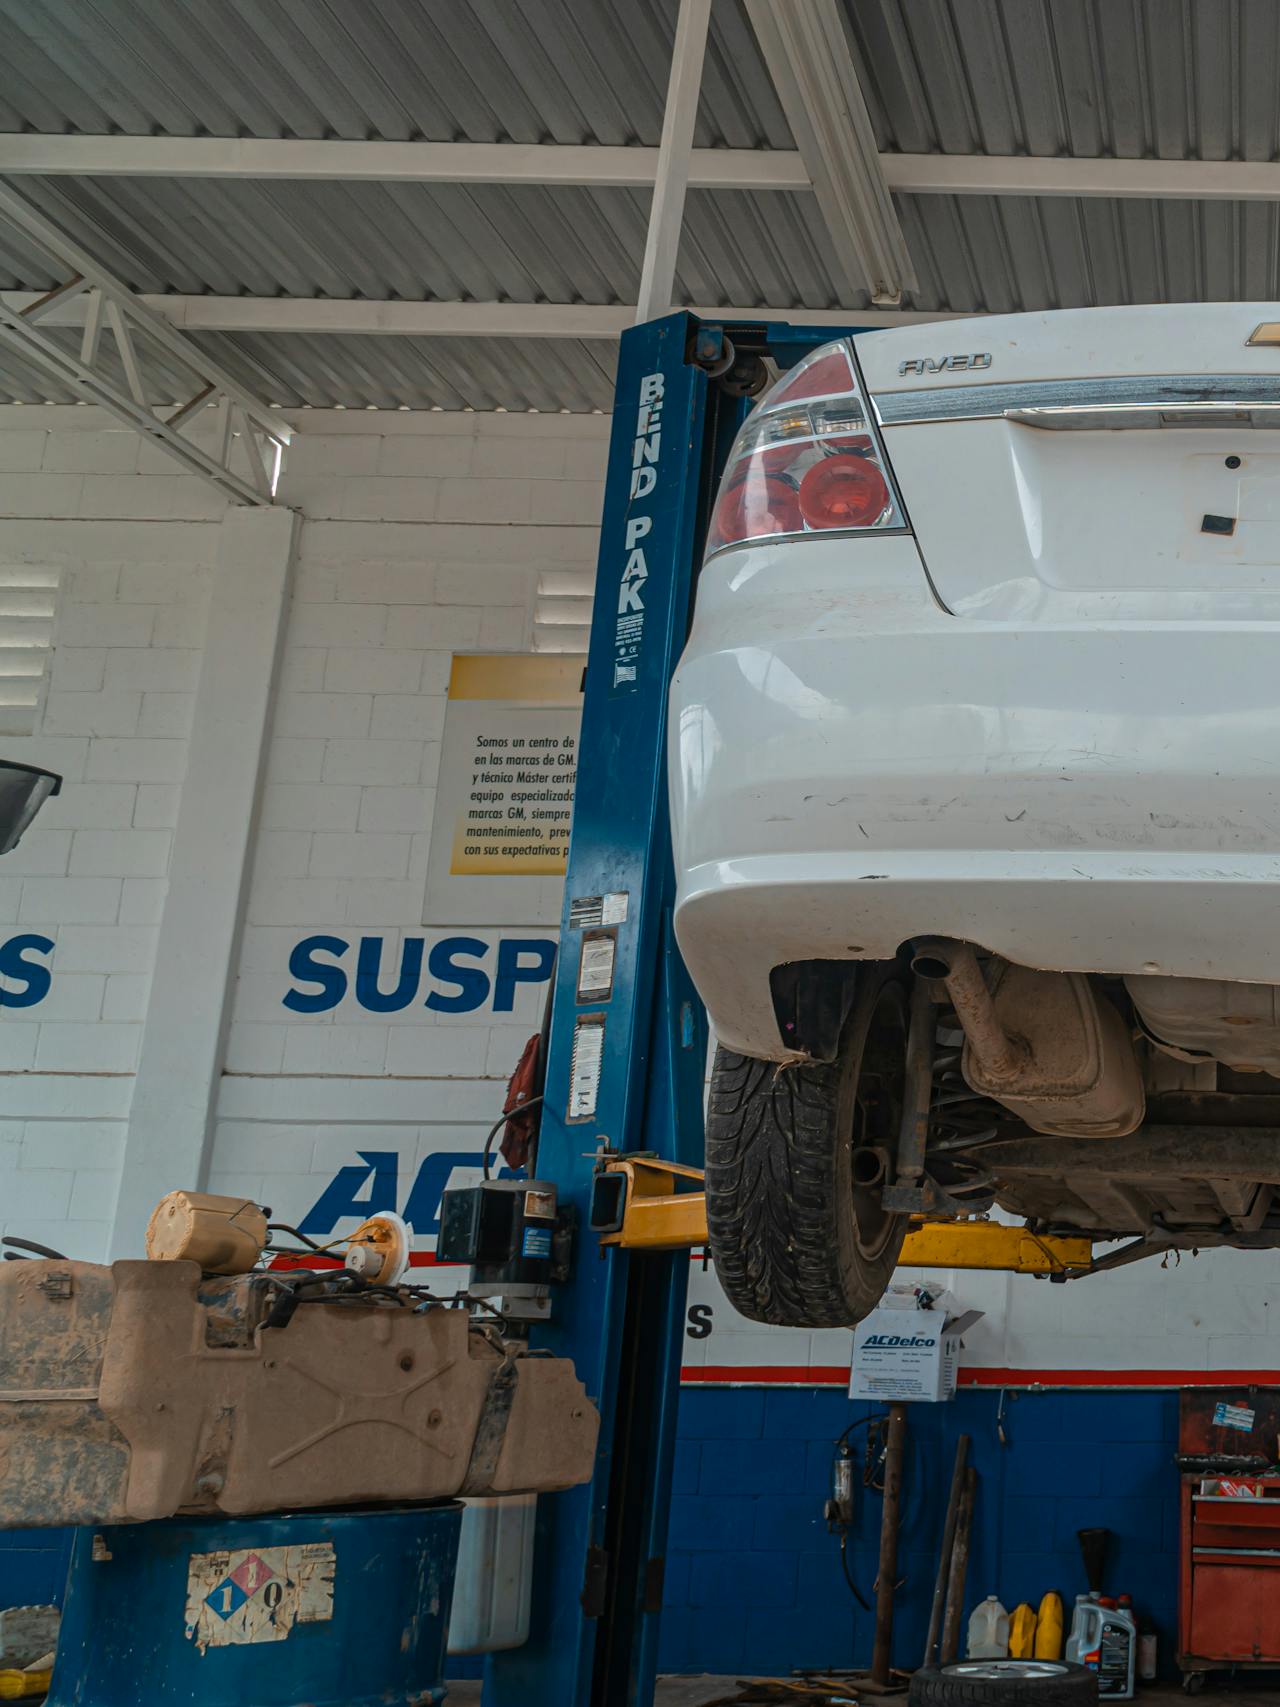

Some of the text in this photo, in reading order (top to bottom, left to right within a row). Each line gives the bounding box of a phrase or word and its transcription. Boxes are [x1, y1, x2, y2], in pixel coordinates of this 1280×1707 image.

[898, 353, 992, 376] AVEO
[629, 372, 665, 500] BEND
[617, 516, 653, 615] PAK
[476, 735, 575, 748] Somos un centro de
[474, 756, 487, 766] en
[489, 753, 503, 766] las
[506, 756, 540, 766] marcas
[543, 753, 555, 766] de
[472, 774, 479, 786] y
[481, 771, 513, 784] técnico
[516, 771, 549, 784] Máster
[470, 789, 504, 803] equipo
[468, 807, 571, 821] marcas GM, siempre
[466, 826, 572, 840] mantenimiento, prev
[464, 846, 481, 856] con
[483, 846, 499, 856] sus
[501, 844, 561, 858] expectativas
[282, 934, 559, 1014] SUSP
[864, 1334, 936, 1347] ACDelco
